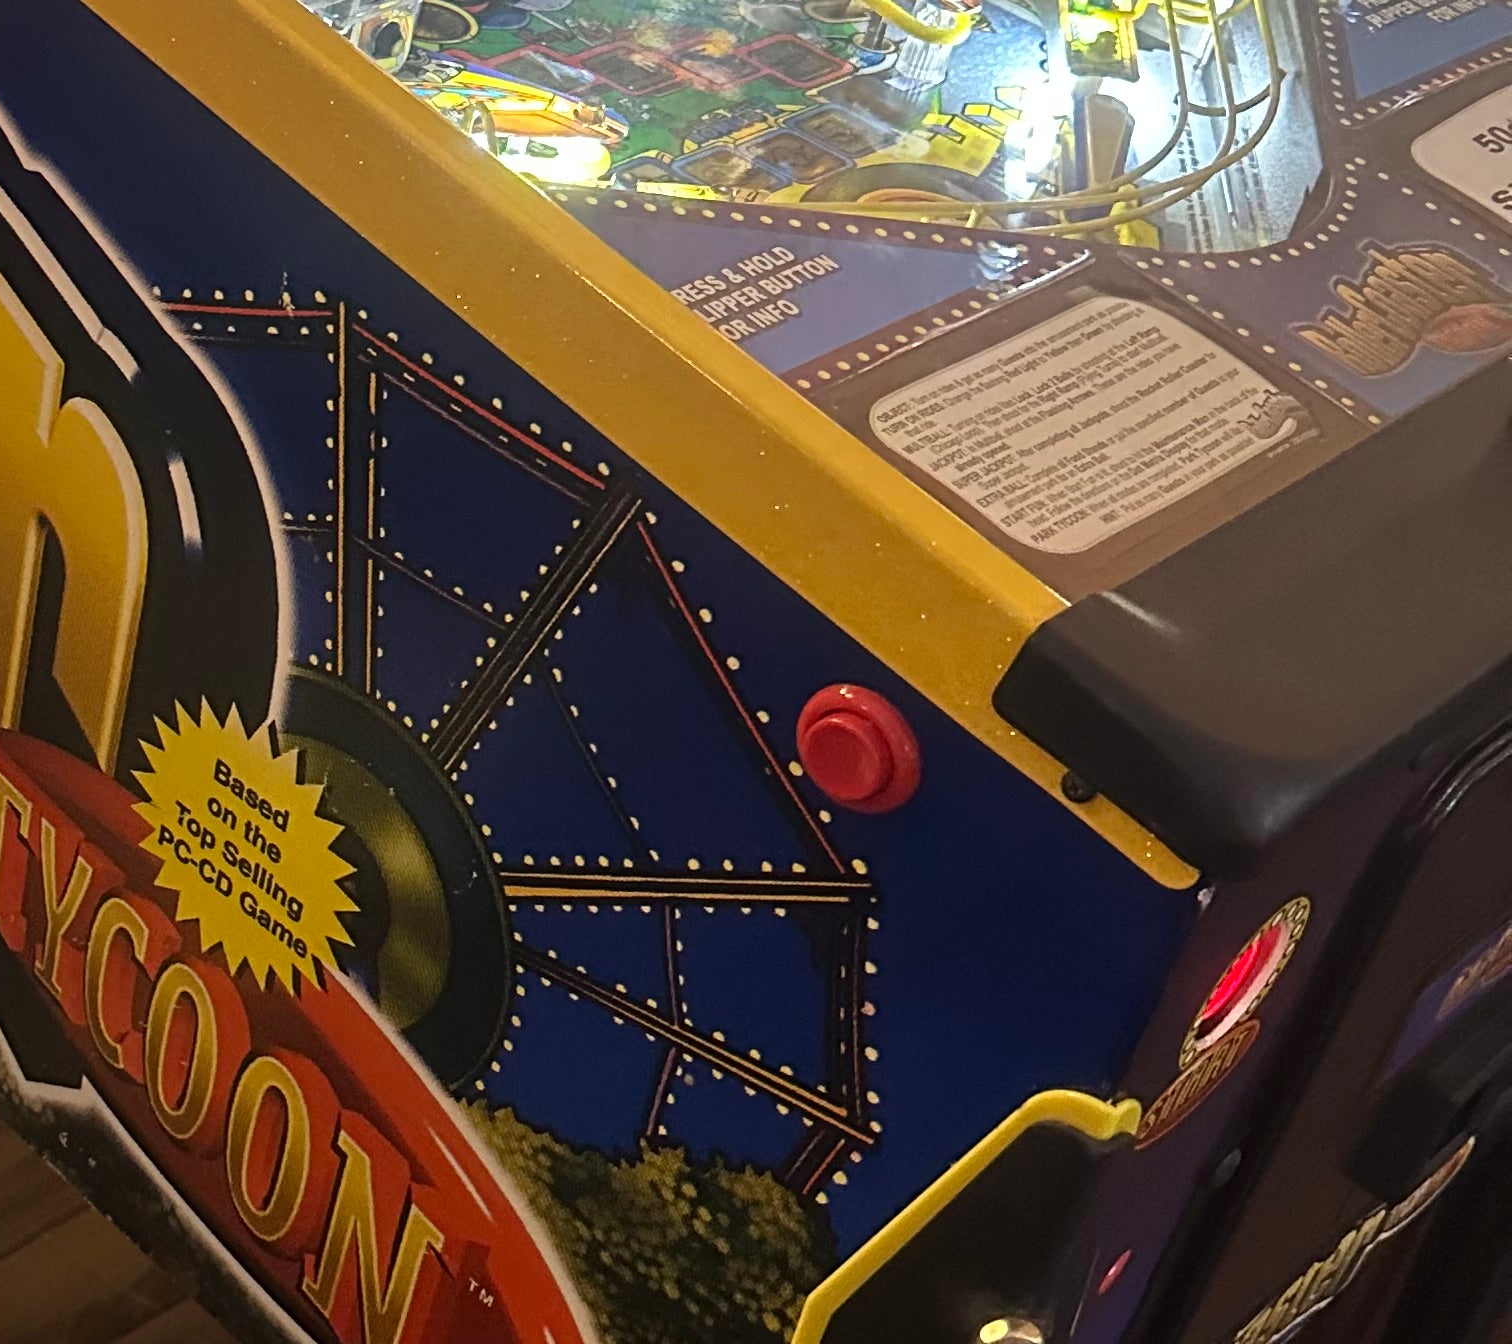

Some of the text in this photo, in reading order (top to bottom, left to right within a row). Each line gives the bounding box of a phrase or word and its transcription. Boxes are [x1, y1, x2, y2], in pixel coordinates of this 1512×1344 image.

[670, 246, 795, 305] RESS & HOLD
[693, 254, 840, 323] LIPPER BUTTON
[718, 299, 800, 341] OR INFO
[213, 757, 290, 832] Based
[175, 800, 304, 922] Top Selling
[207, 797, 282, 863] on the
[157, 824, 308, 958] PC-CD Game
